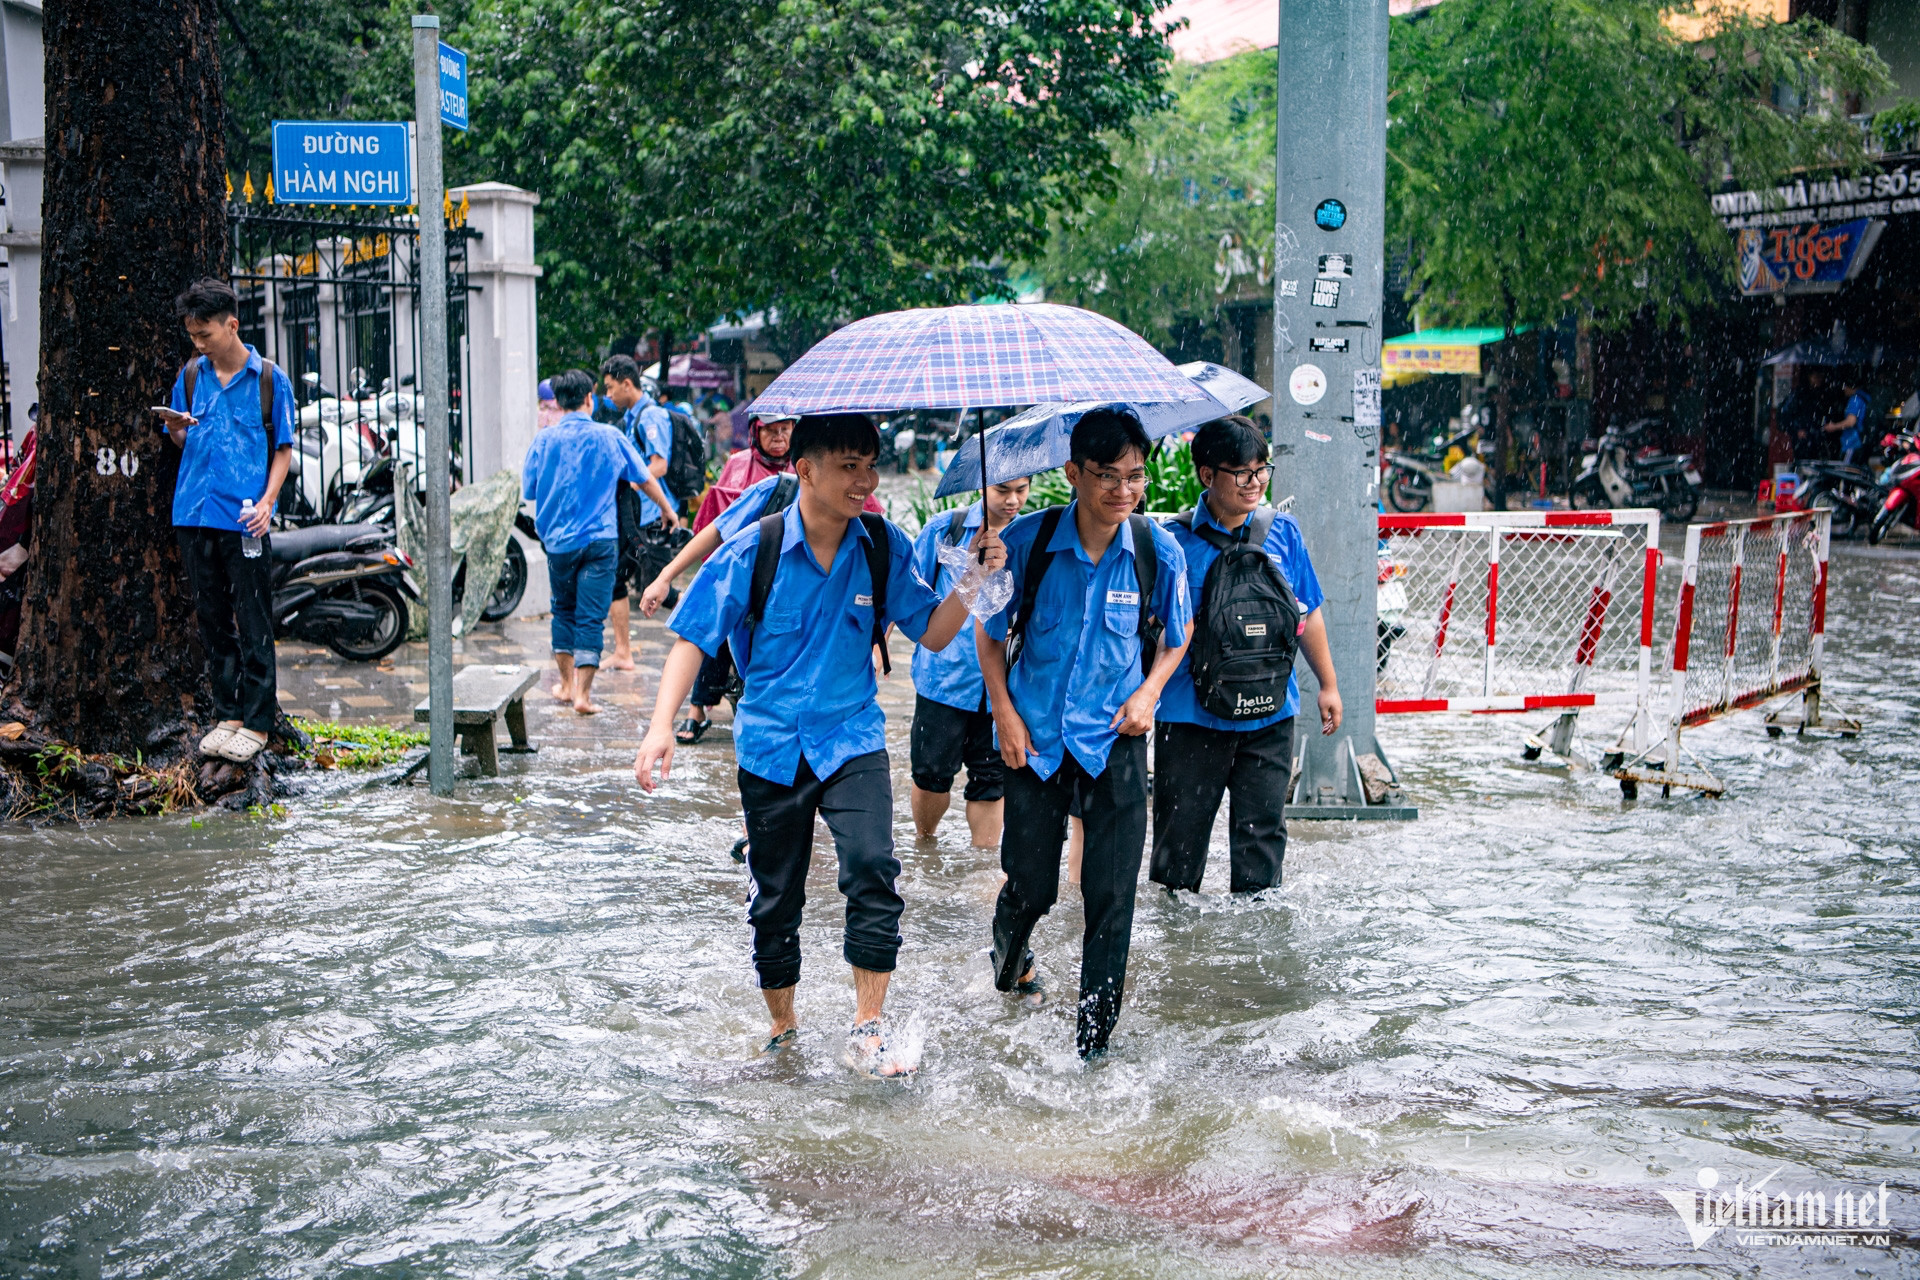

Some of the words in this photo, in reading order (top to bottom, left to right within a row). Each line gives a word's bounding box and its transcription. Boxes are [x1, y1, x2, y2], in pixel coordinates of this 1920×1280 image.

[303, 132, 380, 154] ĐƯỜNG
[284, 163, 336, 193] HÀM
[344, 170, 399, 194] NGHI
[1873, 164, 1909, 199] SỐ
[1769, 223, 1849, 280] Tiger
[96, 447, 139, 478] 80
[1236, 693, 1273, 708] hello
